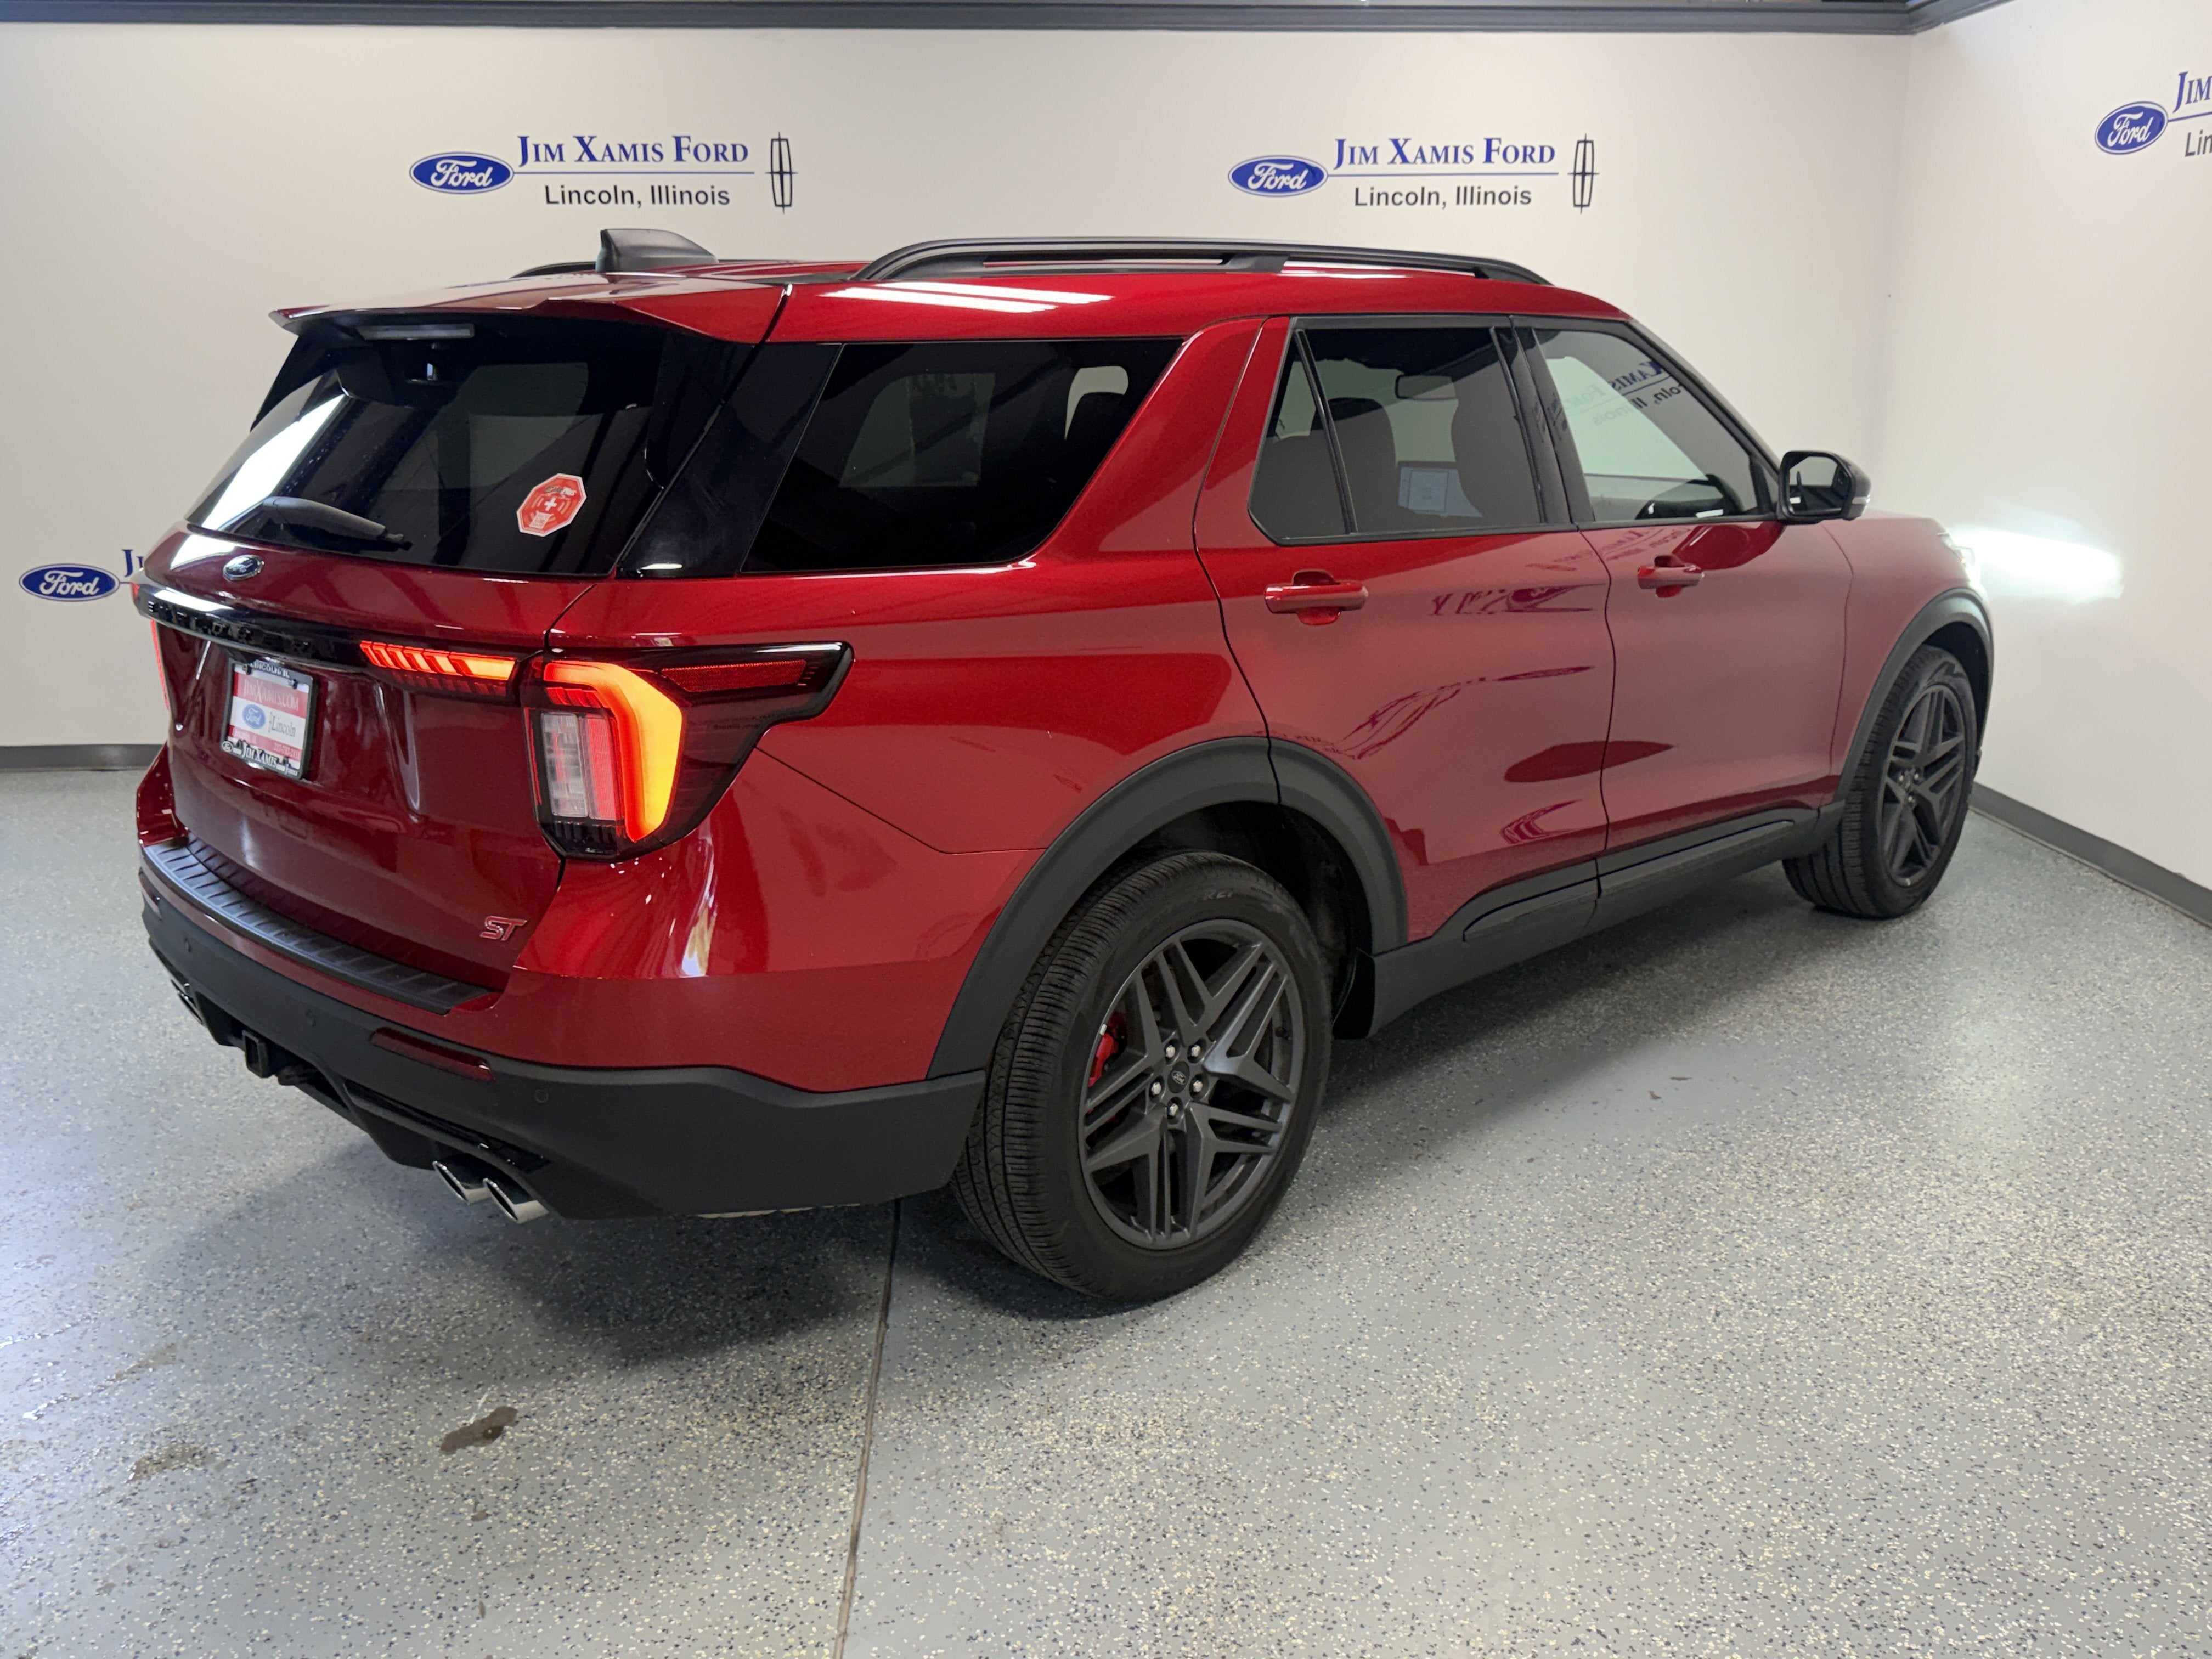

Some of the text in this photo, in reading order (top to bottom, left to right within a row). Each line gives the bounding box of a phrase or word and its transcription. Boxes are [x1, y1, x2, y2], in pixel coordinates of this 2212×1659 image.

[2107, 111, 2154, 147] Ford
[516, 136, 748, 167] JIM XAMIS FORD
[1333, 138, 1555, 170] JIM XAMIS FORD
[430, 159, 493, 188] Ford
[1247, 163, 1310, 191] Ford
[545, 185, 730, 208] Lincoln, Illinois
[1355, 185, 1532, 209] Lincoln, Illinois
[40, 570, 100, 596] Ford
[272, 716, 296, 737] Lincoln
[242, 742, 255, 760] JIM
[255, 748, 277, 768] XAMIS
[479, 915, 528, 941] ST
